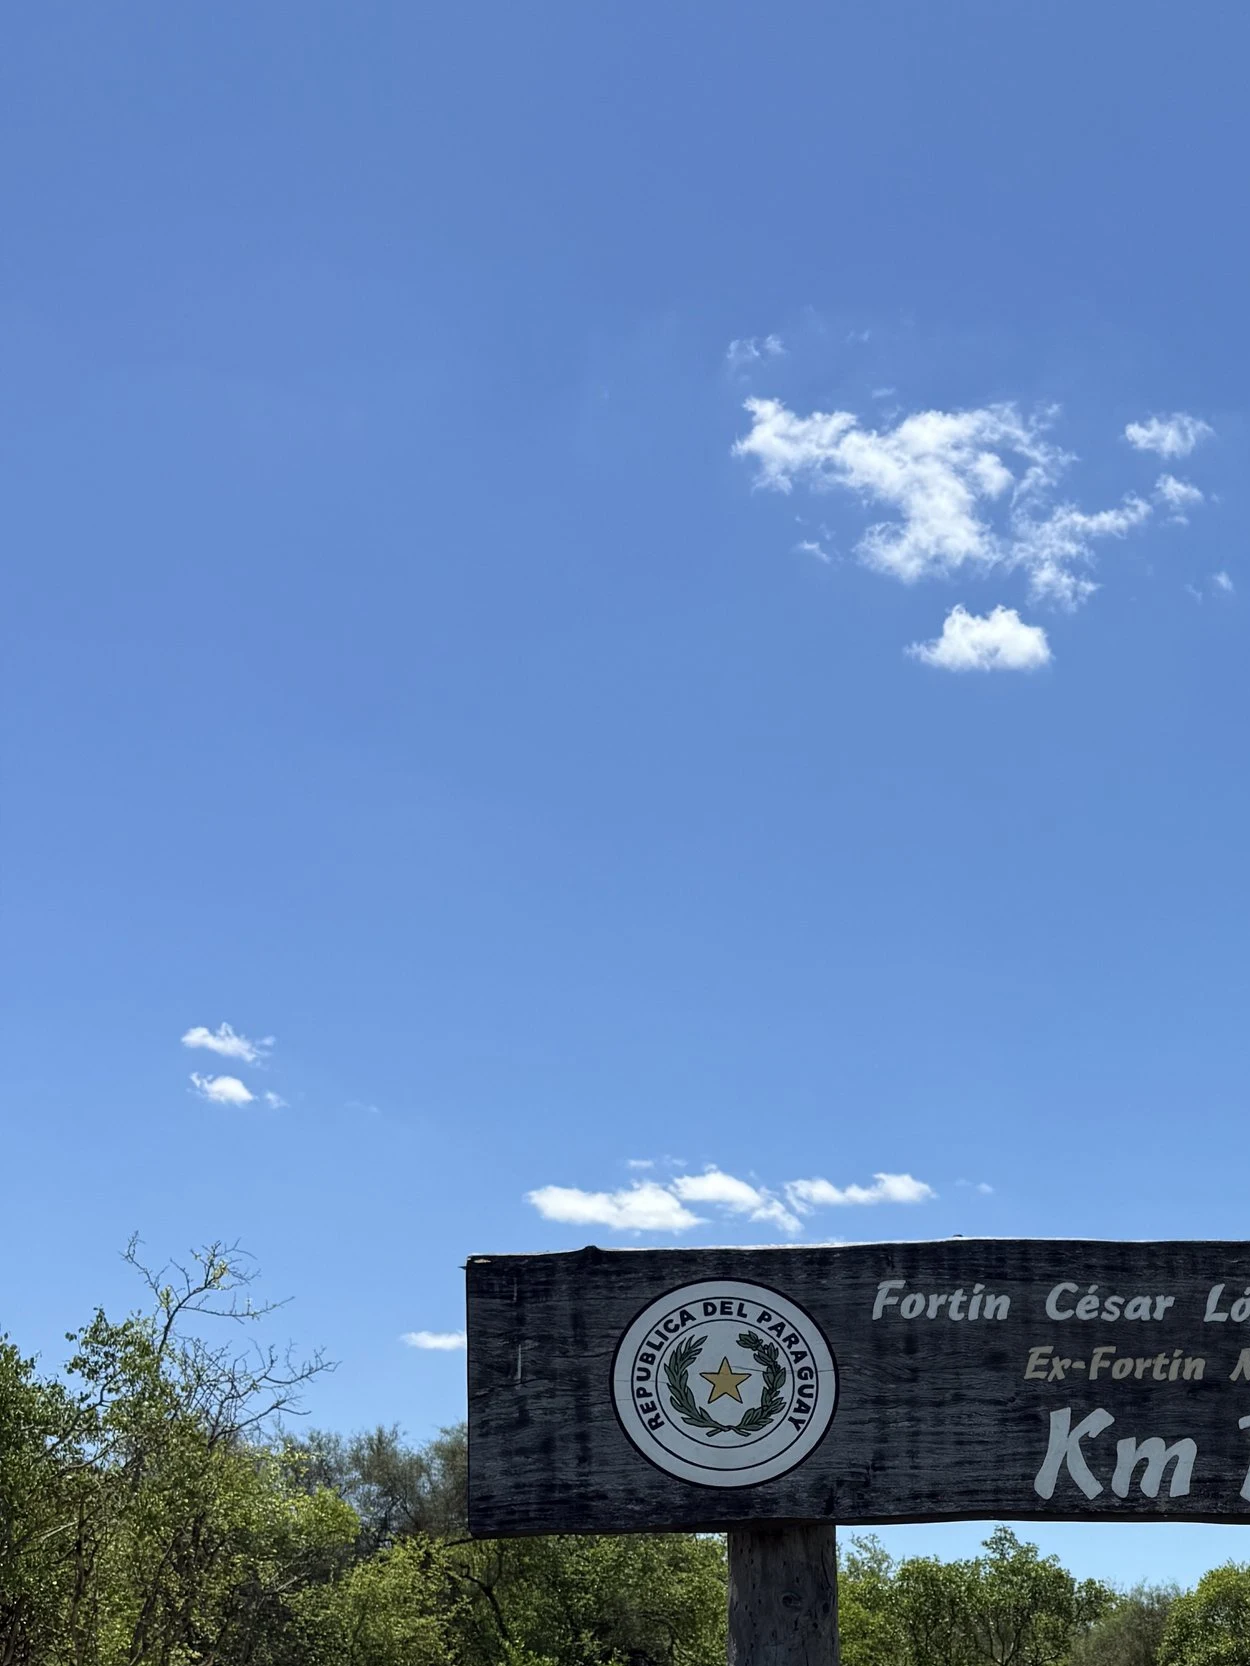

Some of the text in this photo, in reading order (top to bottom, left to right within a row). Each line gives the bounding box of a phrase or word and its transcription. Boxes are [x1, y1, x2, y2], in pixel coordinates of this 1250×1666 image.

[1045, 1282, 1175, 1321] César
[635, 1300, 815, 1432] REPUBLICA DEL PARAGUAY
[1033, 1407, 1198, 1500] Km
